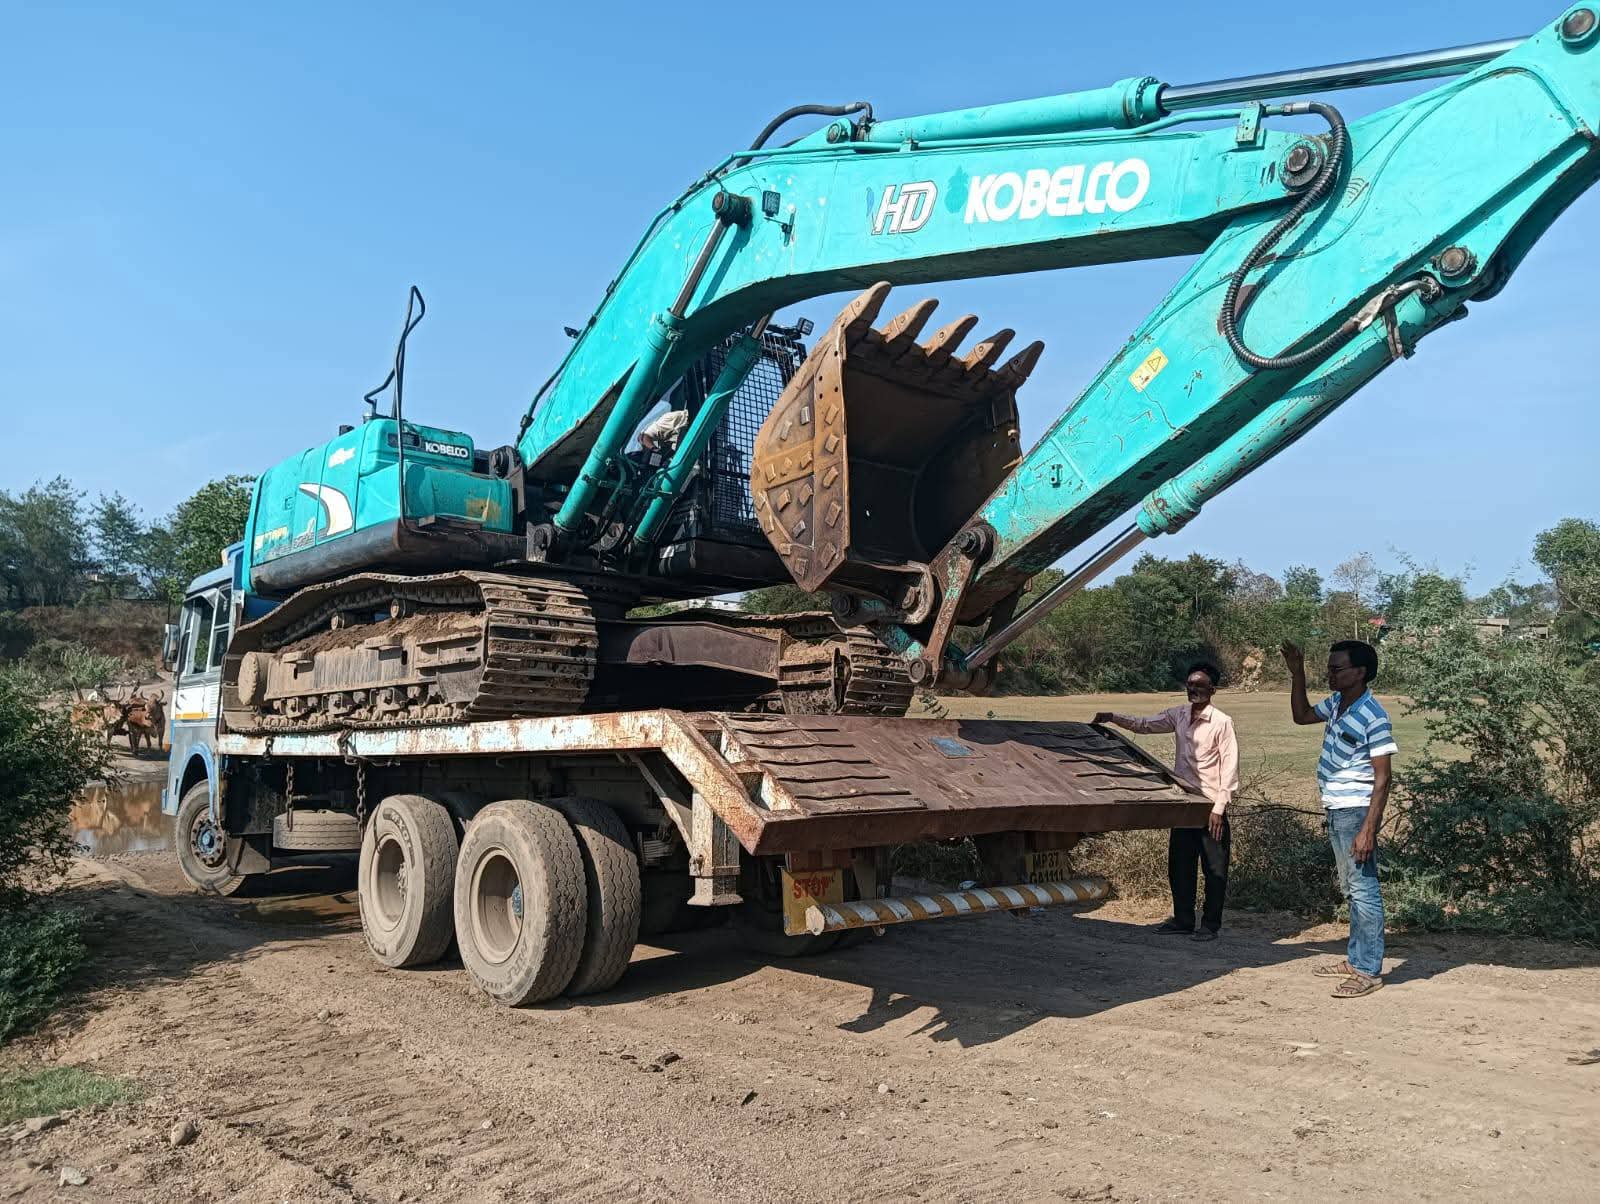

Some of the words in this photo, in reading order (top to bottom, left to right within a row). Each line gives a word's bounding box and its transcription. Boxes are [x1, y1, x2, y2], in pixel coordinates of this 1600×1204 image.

[871, 180, 938, 235] HD
[964, 158, 1150, 224] KOBELCO
[425, 442, 469, 458] KOBELCO
[793, 876, 829, 899] STOP
